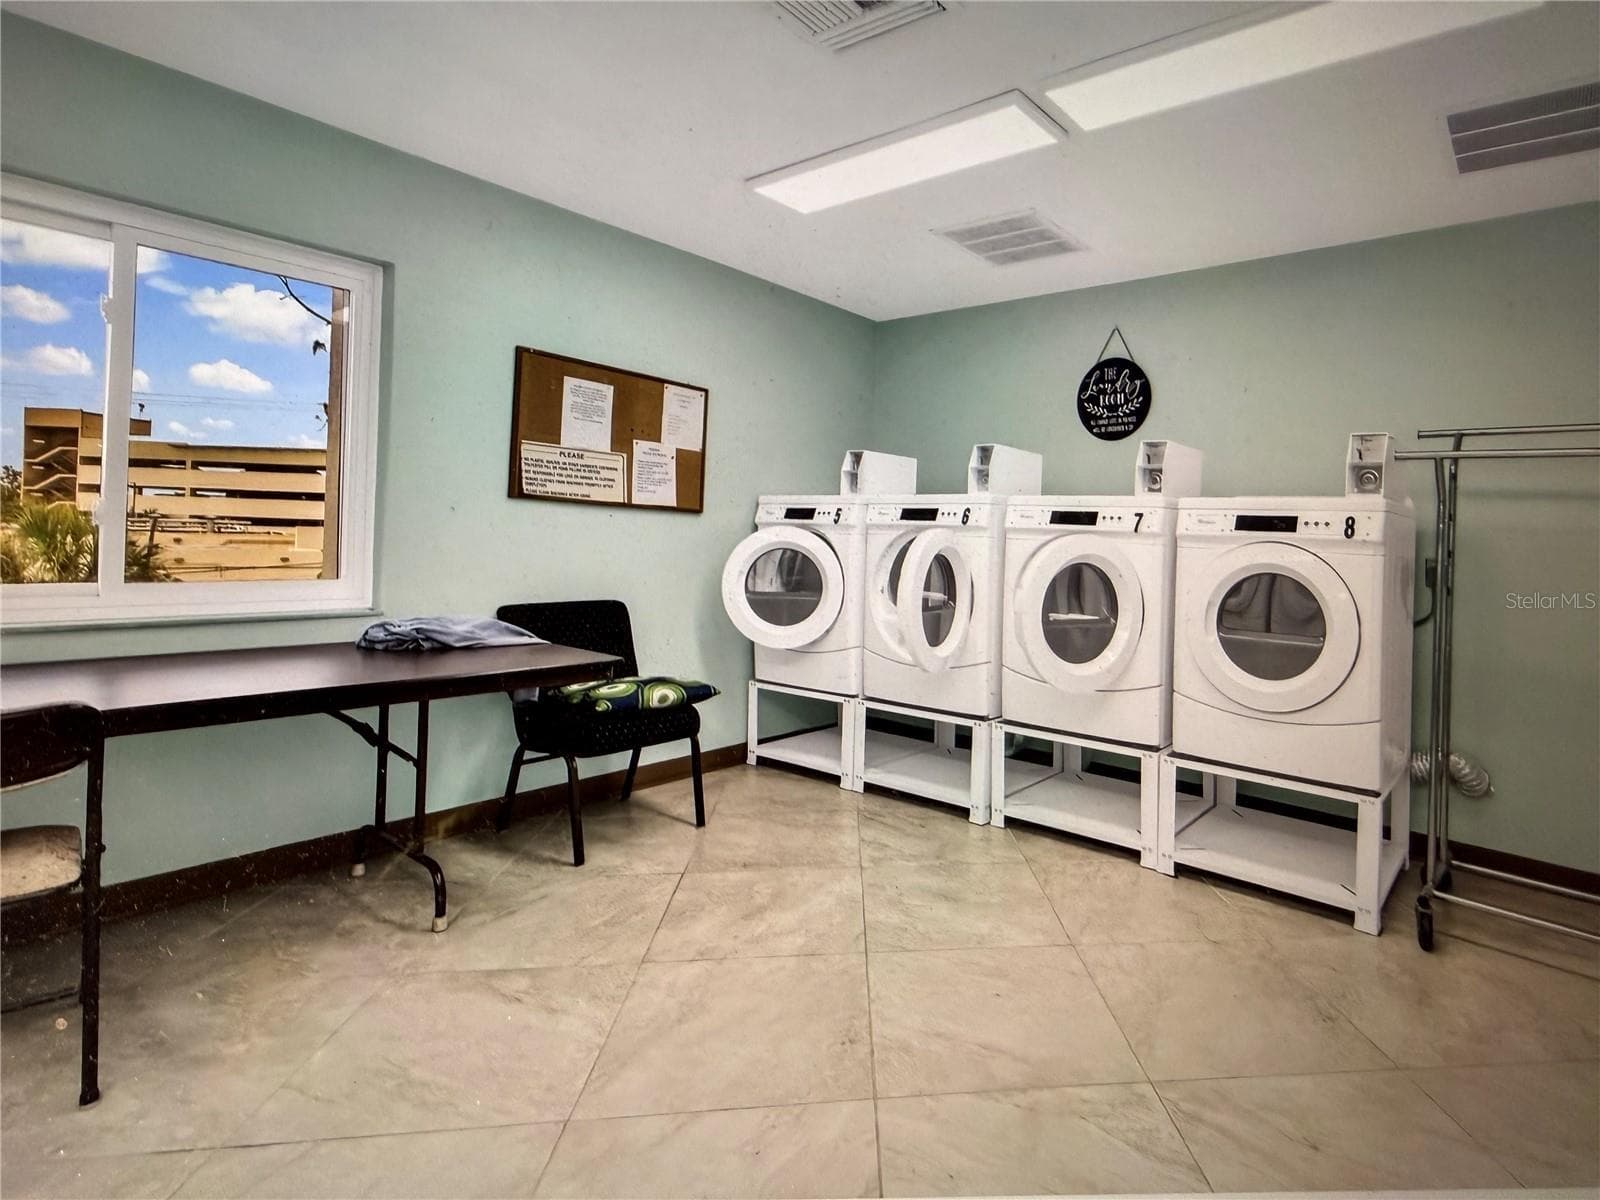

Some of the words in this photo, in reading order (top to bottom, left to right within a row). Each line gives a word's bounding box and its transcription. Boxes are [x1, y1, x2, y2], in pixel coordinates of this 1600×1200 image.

[559, 451, 585, 460] PLEASE
[833, 507, 843, 525] 5
[961, 507, 971, 526] 6
[1133, 512, 1144, 533] 7
[1343, 515, 1356, 539] 8
